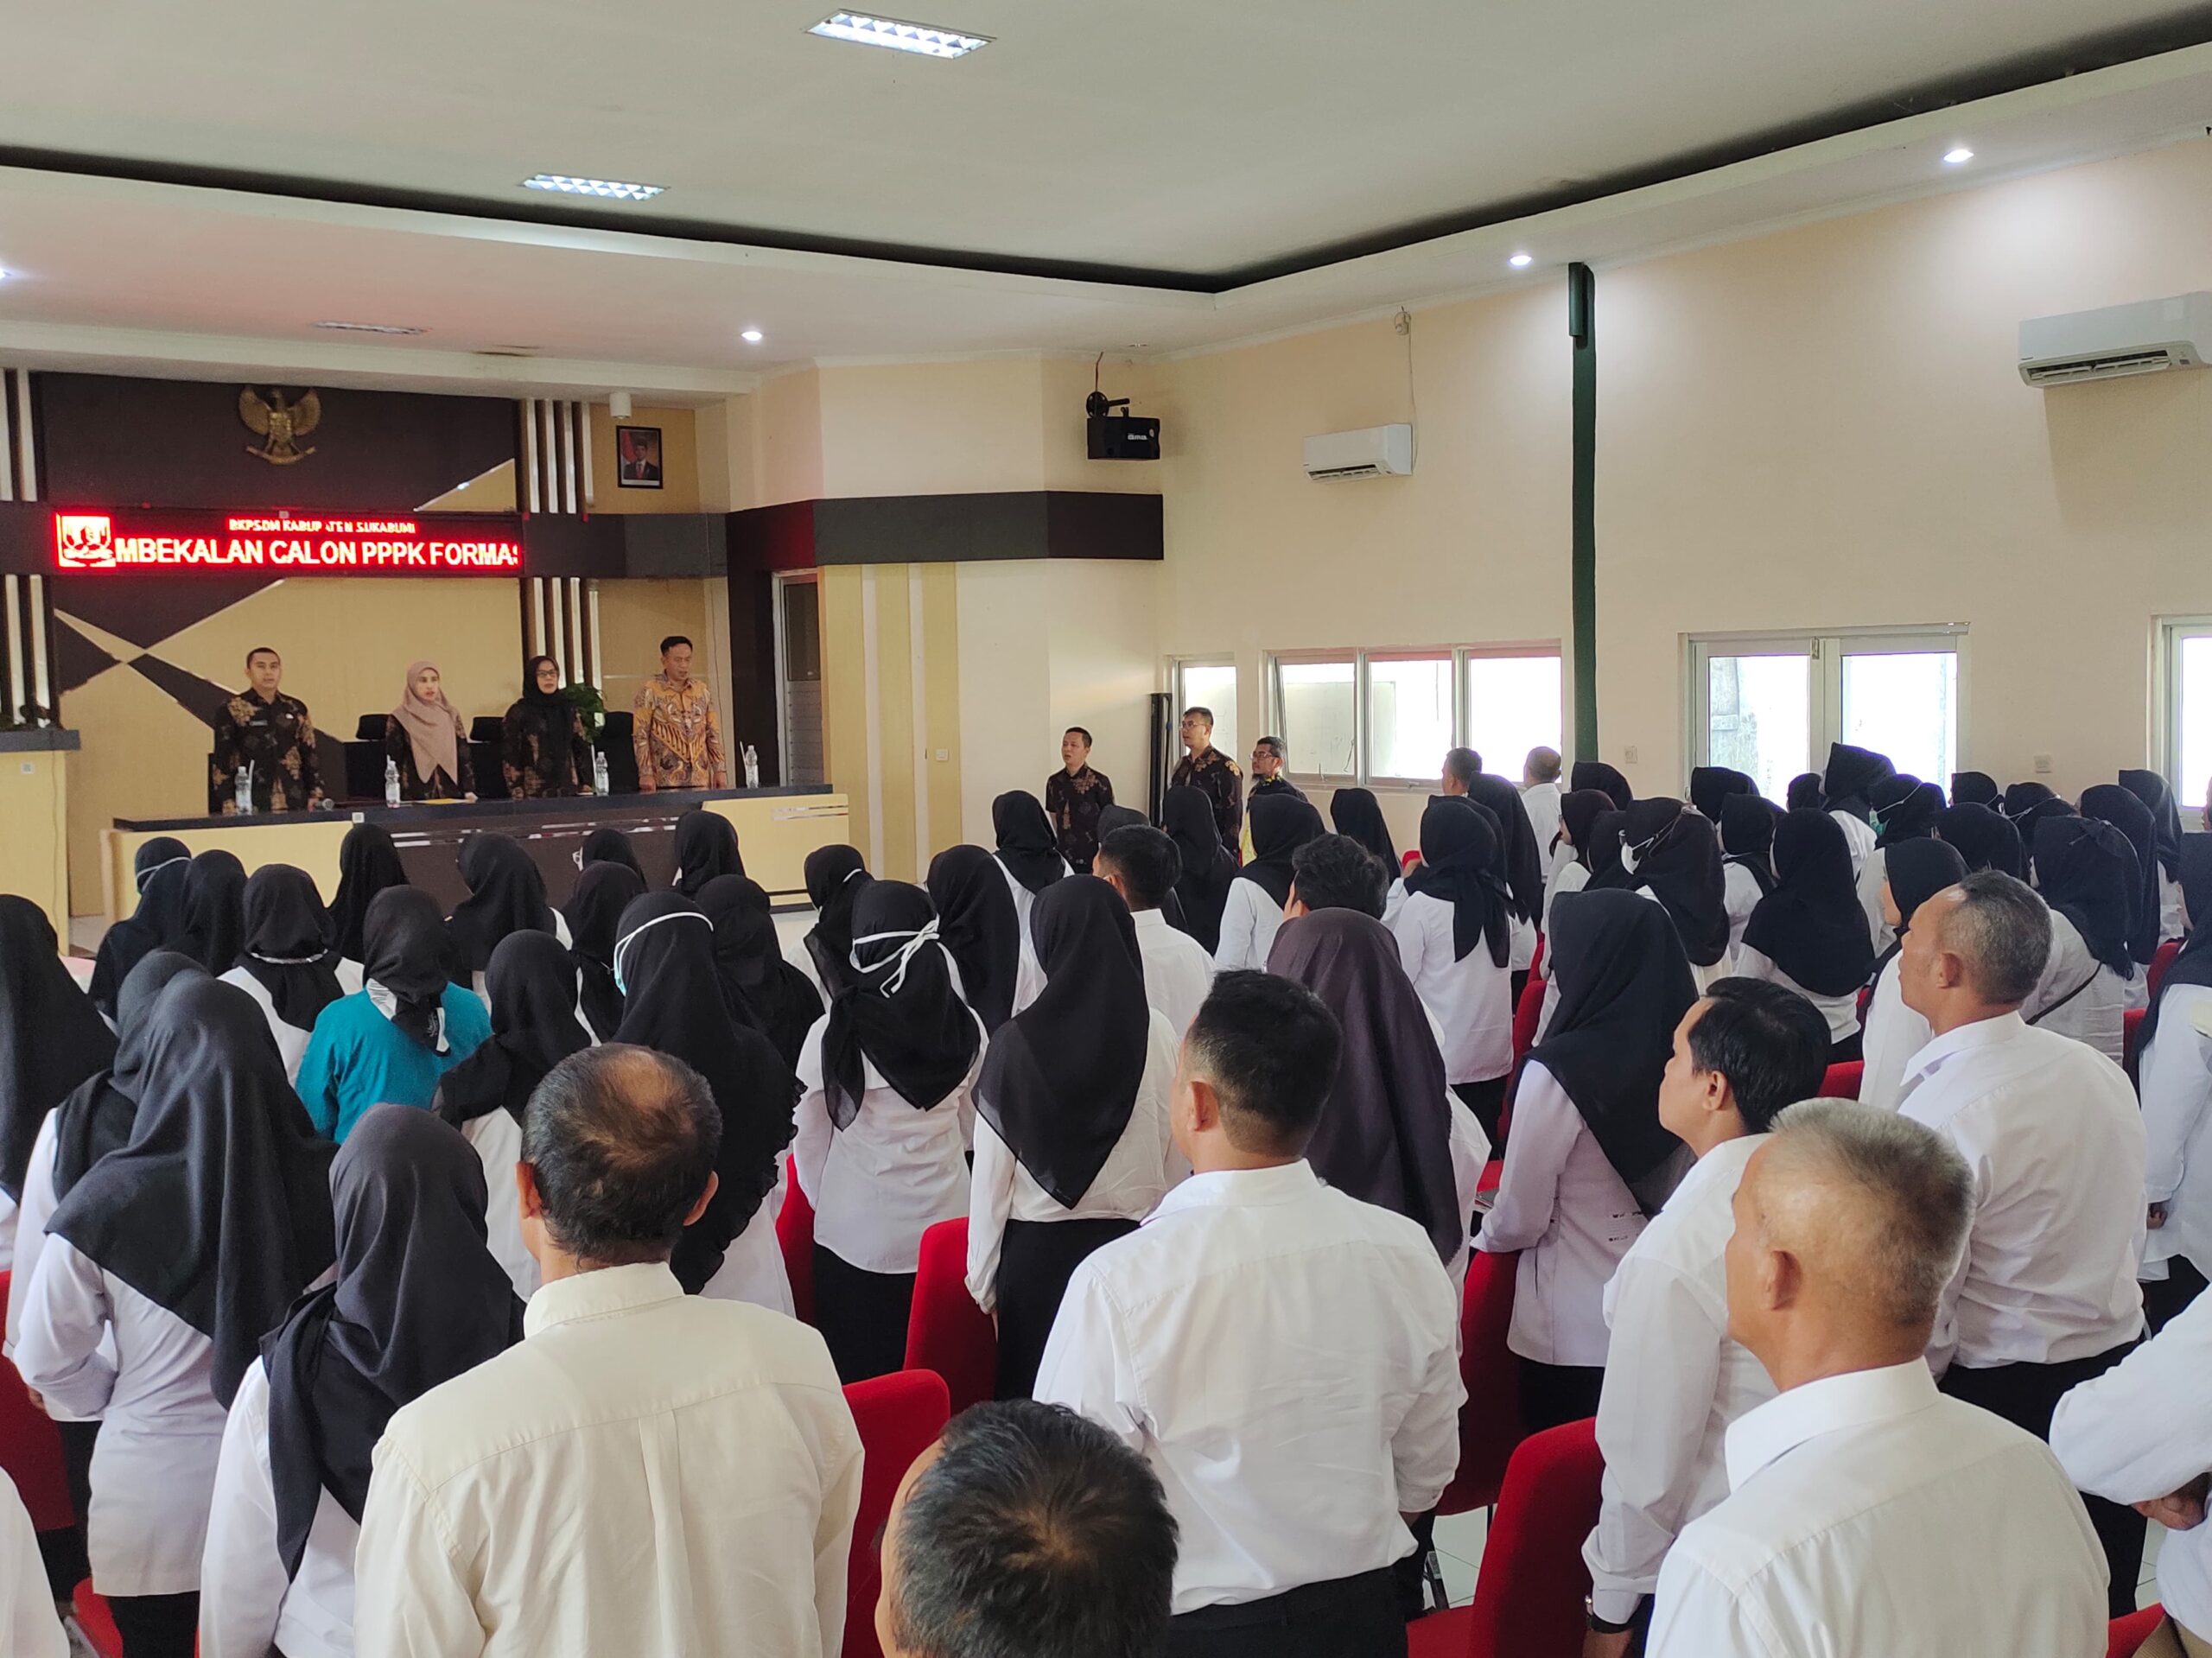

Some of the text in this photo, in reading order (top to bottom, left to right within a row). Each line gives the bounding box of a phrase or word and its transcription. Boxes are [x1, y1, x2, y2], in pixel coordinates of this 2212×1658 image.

[115, 538, 264, 563] MBEKALAN
[270, 540, 356, 565] CALON
[361, 542, 426, 565] PPPK
